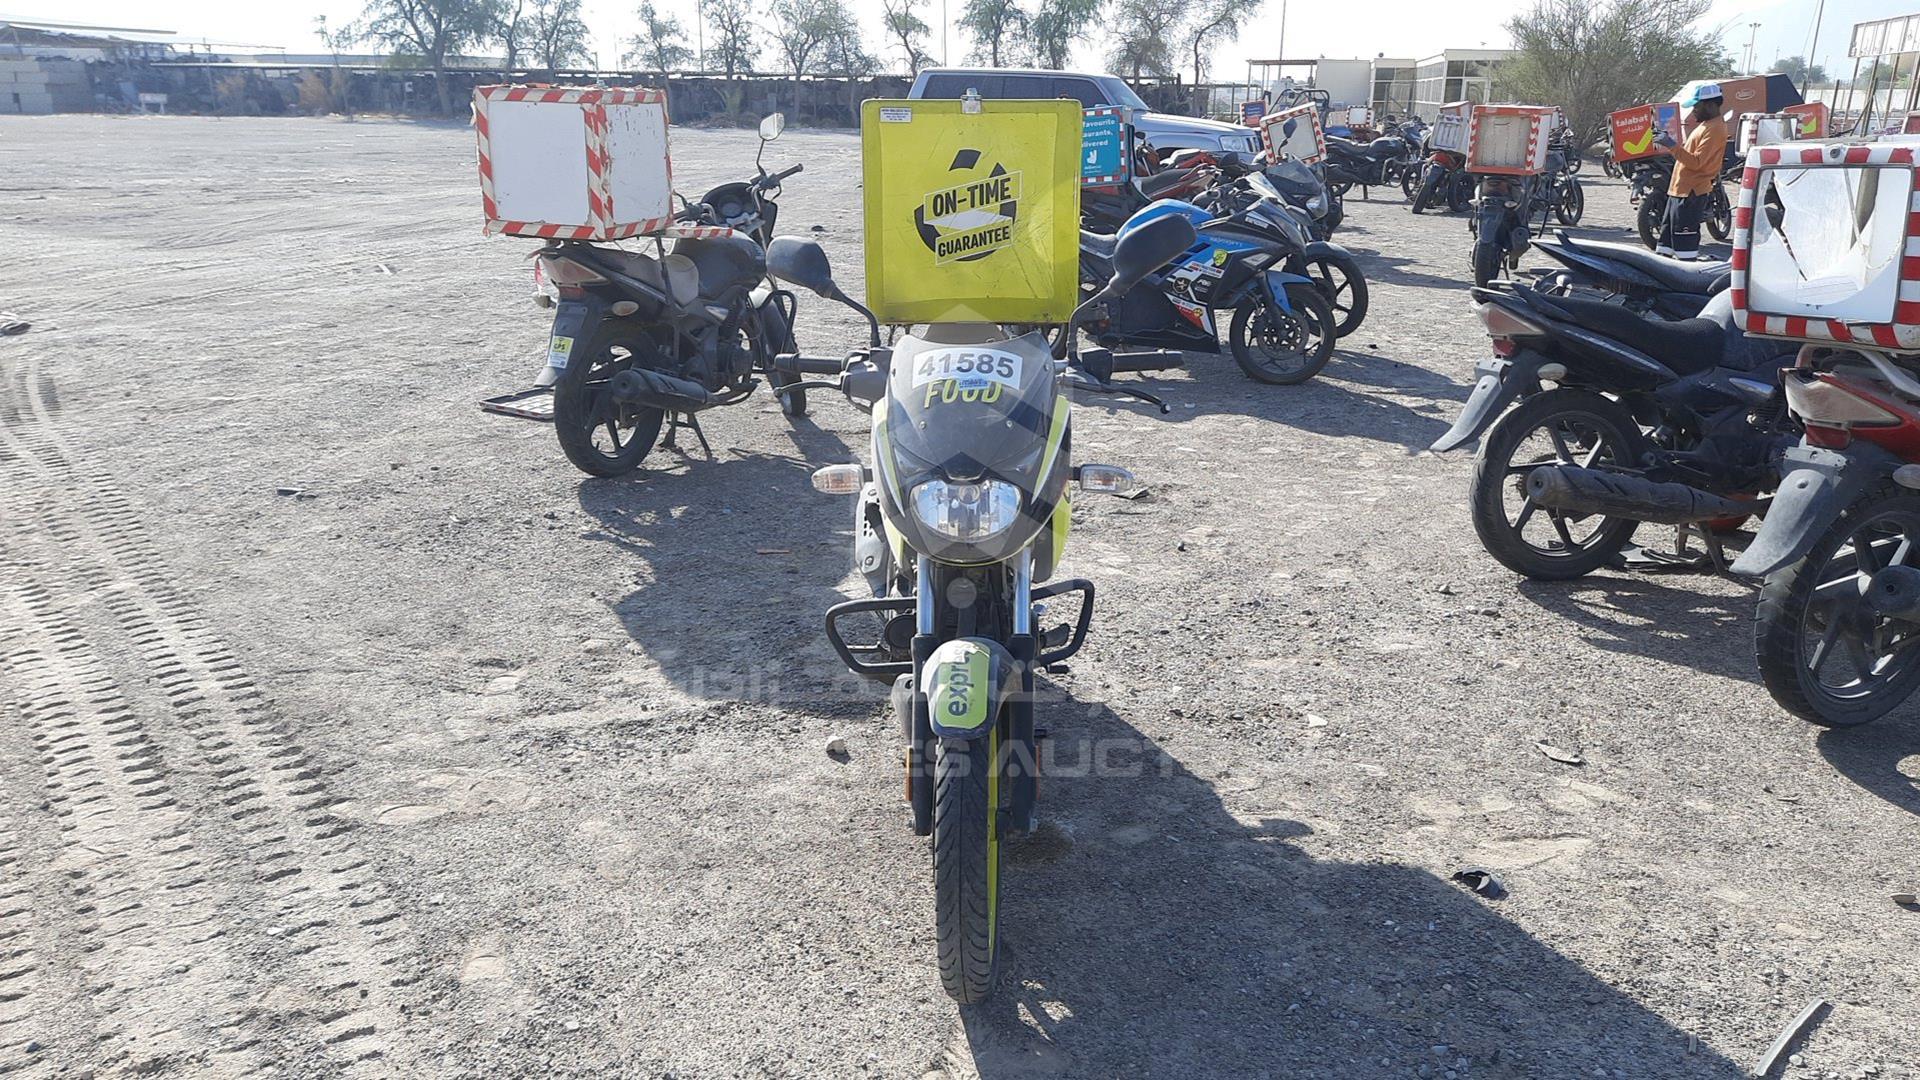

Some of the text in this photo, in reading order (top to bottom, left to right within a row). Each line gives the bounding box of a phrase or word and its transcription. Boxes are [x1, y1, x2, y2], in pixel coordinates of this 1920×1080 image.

[1082, 129, 1113, 138] aurants,
[1616, 114, 1648, 127] talabat
[932, 177, 1011, 217] ON-TIME
[938, 226, 1010, 257] GUARANTEE
[918, 353, 1014, 379] 41585
